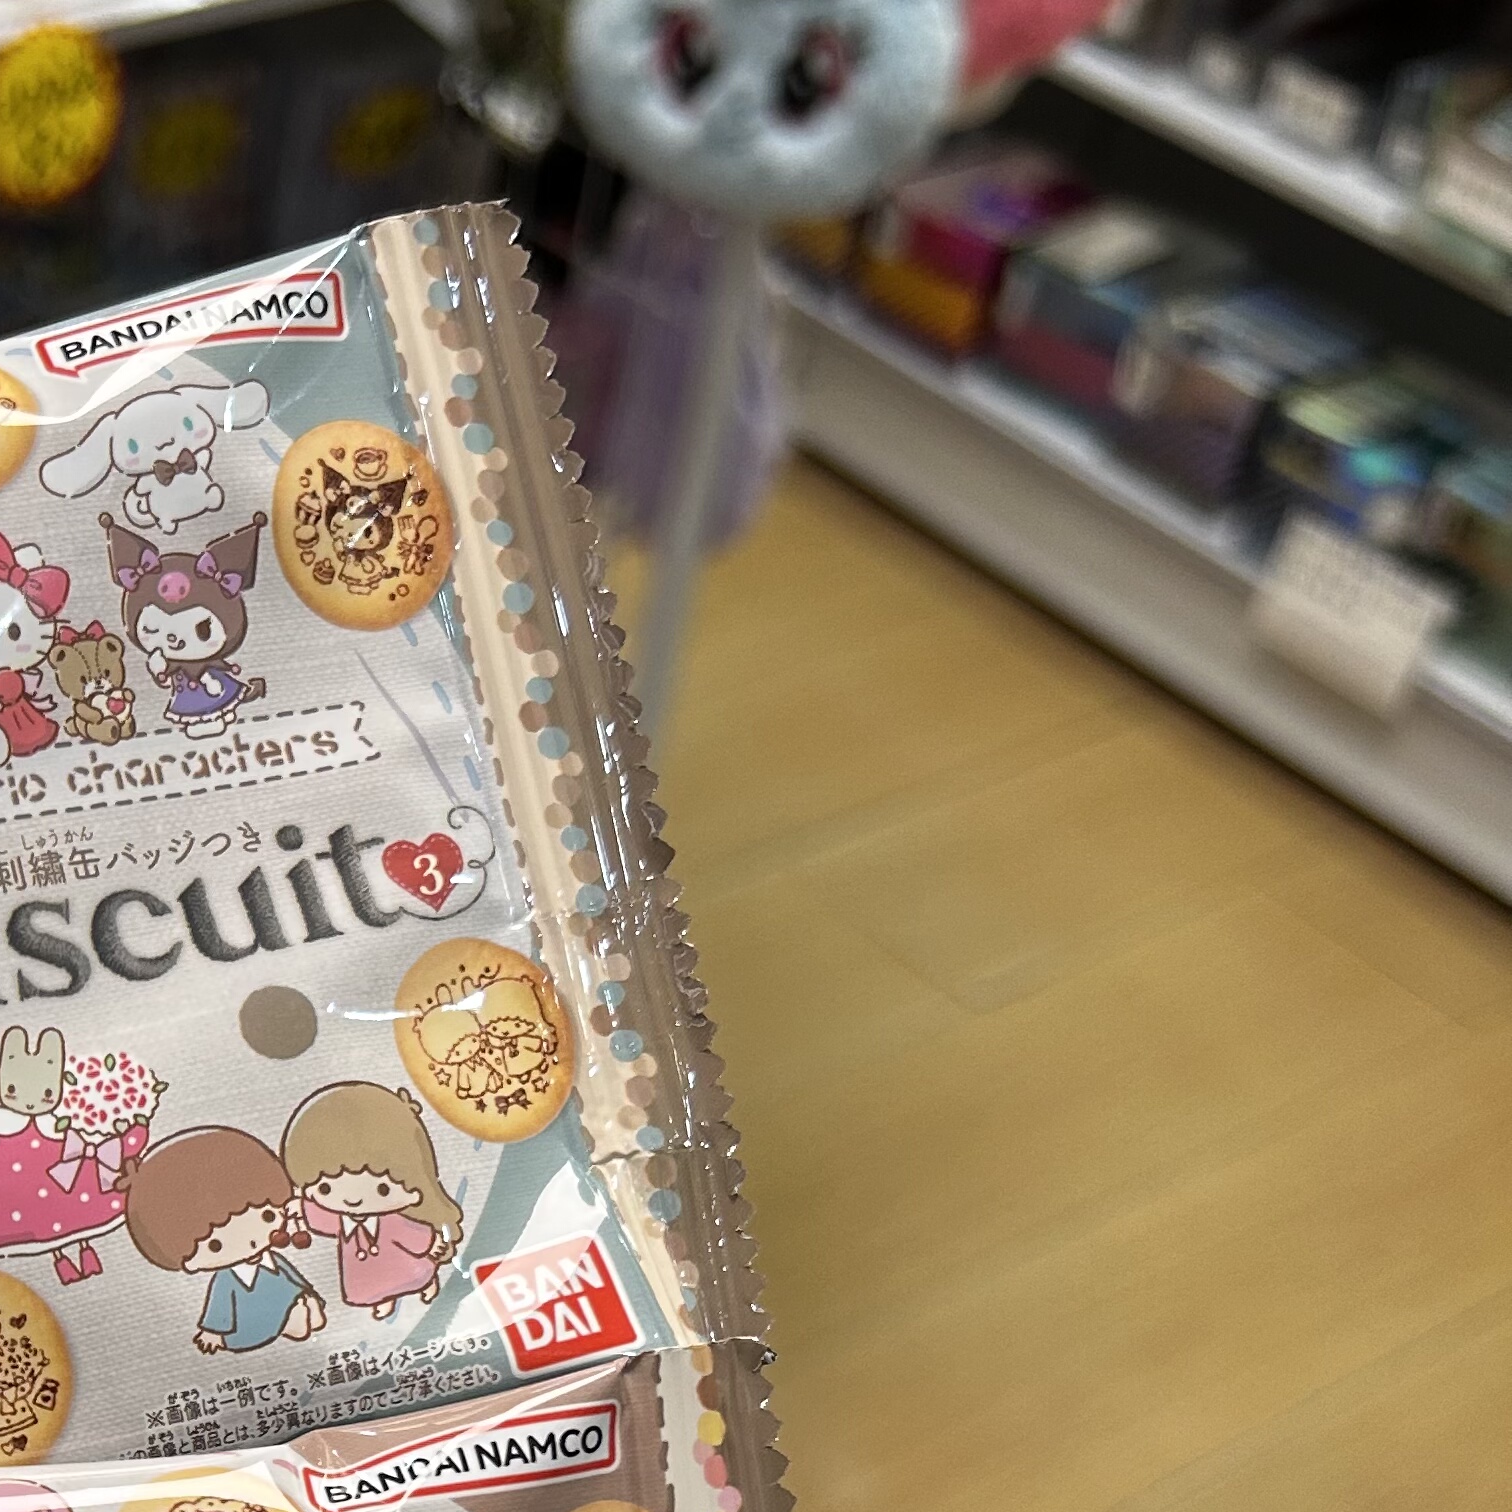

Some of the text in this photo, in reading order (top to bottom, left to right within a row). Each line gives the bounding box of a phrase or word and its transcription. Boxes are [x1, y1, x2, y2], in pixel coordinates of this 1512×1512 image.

[60, 290, 329, 363] BANDAI NAMCO
[67, 725, 340, 797] characters
[412, 851, 445, 897] 3
[324, 1425, 603, 1504] BANDAI NAMCO
